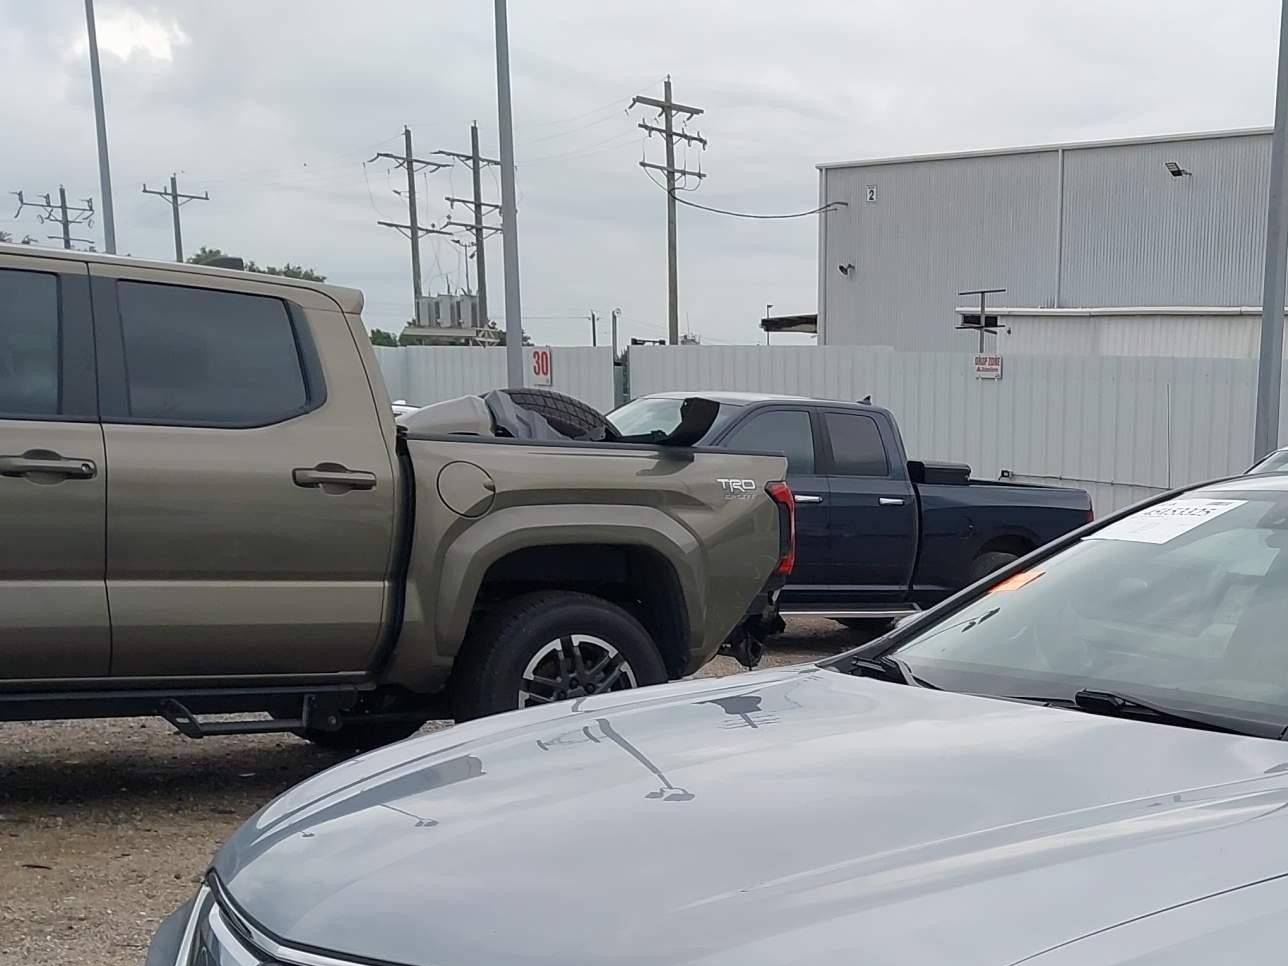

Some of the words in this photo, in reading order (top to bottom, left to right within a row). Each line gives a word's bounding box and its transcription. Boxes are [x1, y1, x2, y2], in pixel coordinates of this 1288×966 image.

[868, 189, 875, 201] 2
[533, 350, 549, 376] 30
[716, 478, 756, 493] TRD
